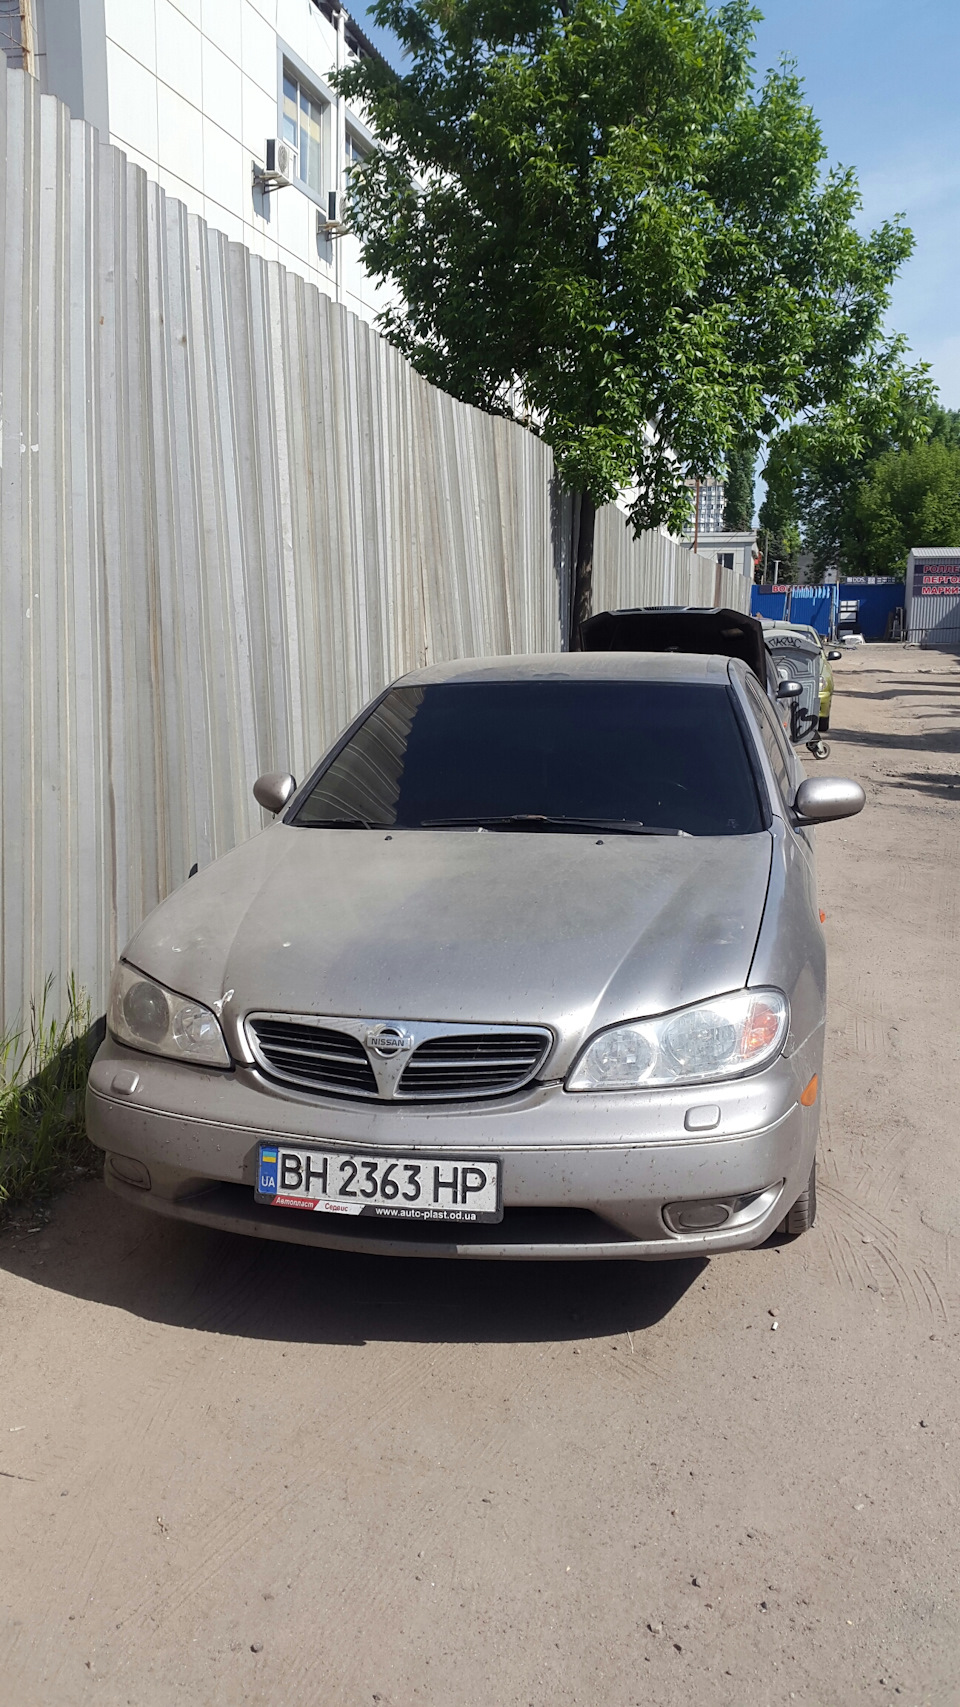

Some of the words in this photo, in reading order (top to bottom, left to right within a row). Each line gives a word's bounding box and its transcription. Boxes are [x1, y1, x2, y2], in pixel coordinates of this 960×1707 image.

[923, 576, 960, 584] ПЕРГО
[371, 1038, 405, 1047] NISSAN
[261, 1175, 276, 1188] UA
[338, 1160, 422, 1201] 2363
[375, 1207, 477, 1221] www.auto-plast.od.ua
